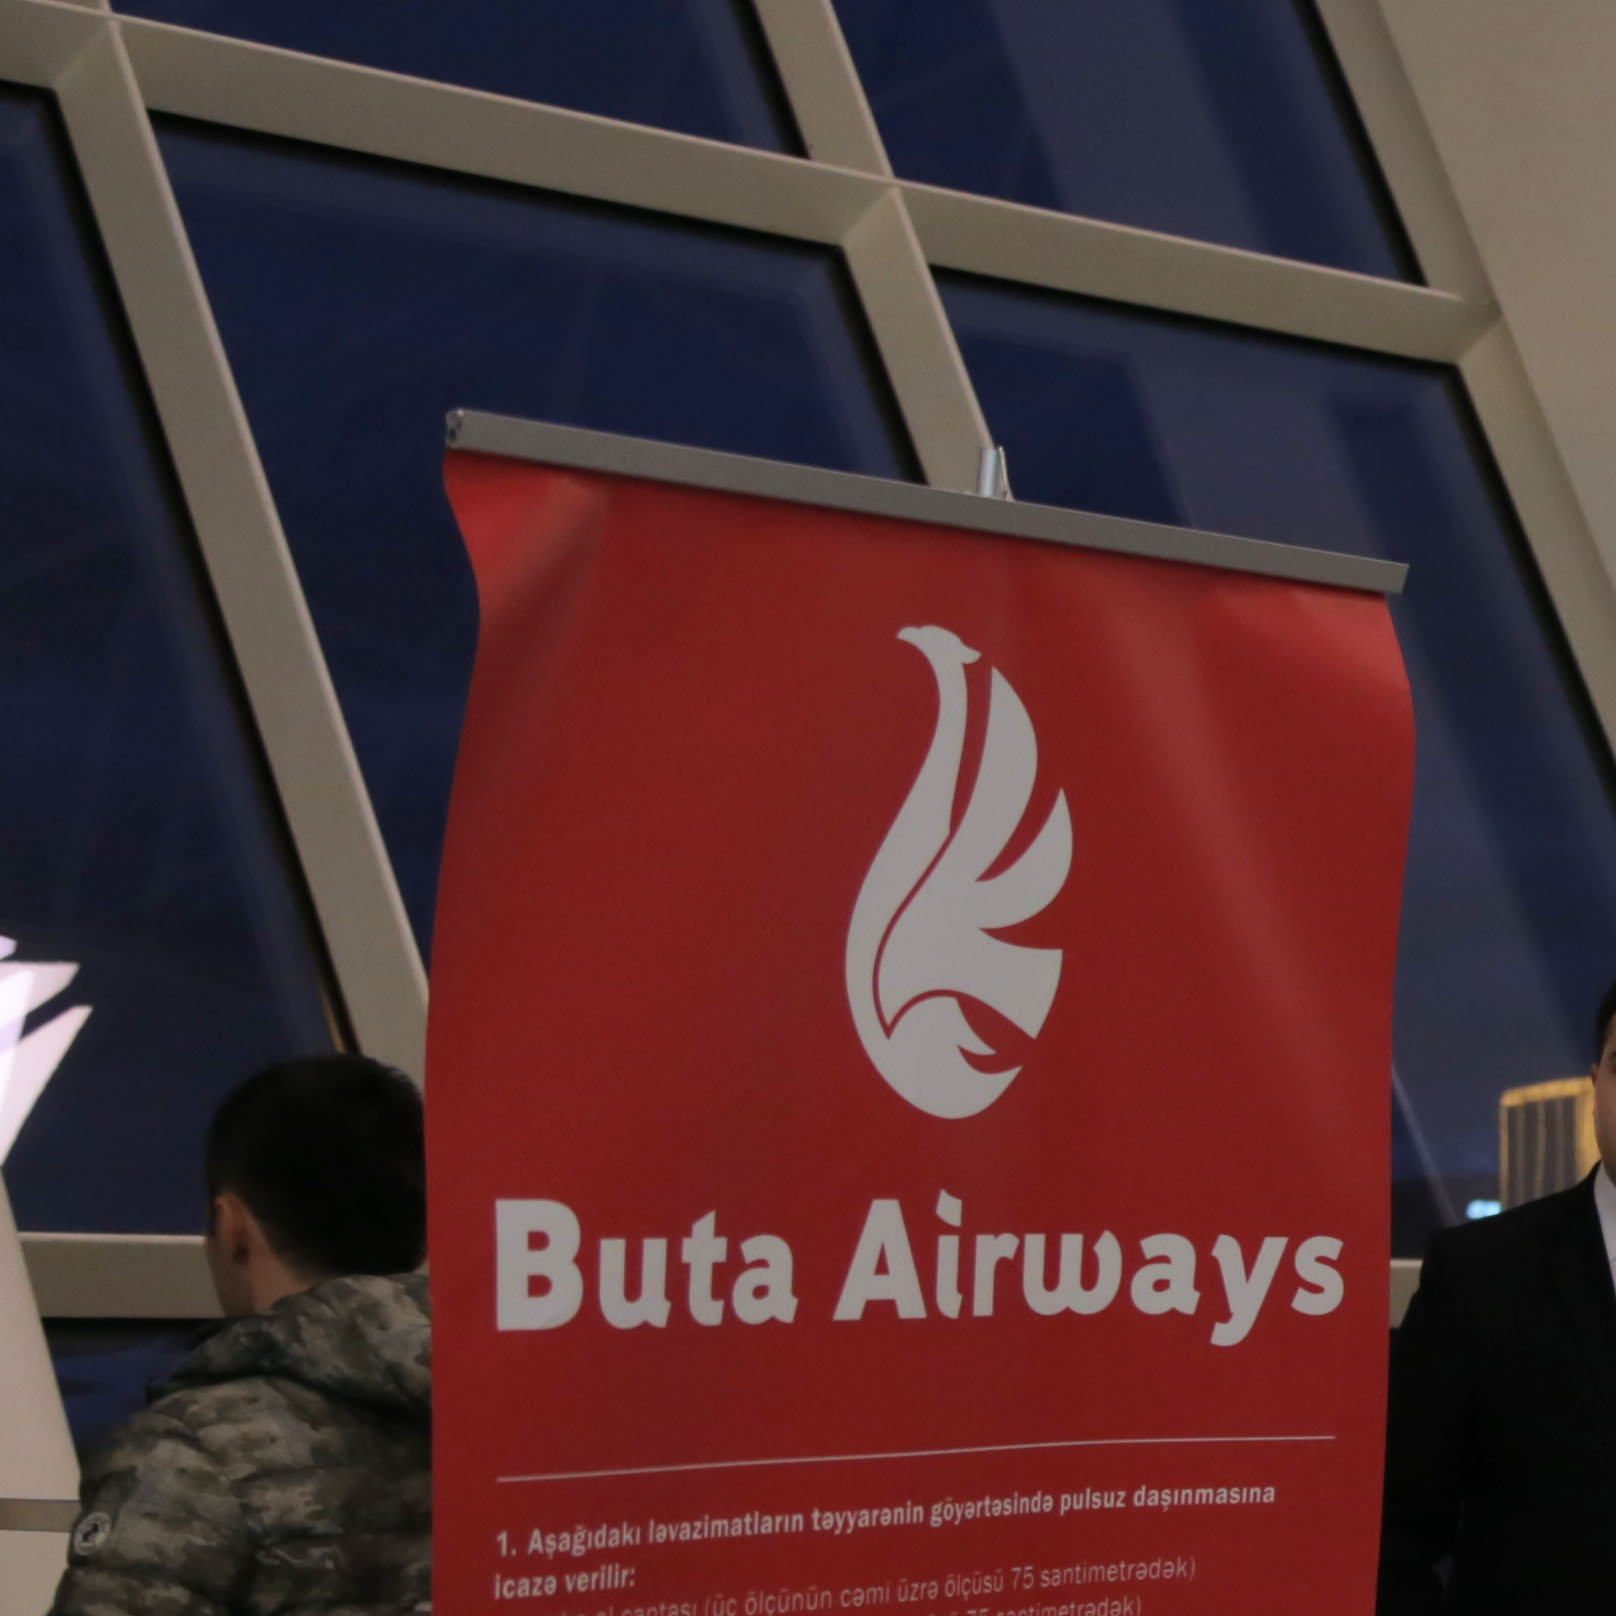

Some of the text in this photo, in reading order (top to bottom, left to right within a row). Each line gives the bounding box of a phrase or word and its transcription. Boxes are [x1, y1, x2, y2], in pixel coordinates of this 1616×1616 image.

[495, 1189, 1346, 1347] Buta Airways
[497, 1484, 1275, 1559] 1. Aşağıdakı ləvazimatların təyyarənin göyərtəsində pulsuz daşınmasına
[494, 1563, 635, 1600] icazə verilir:
